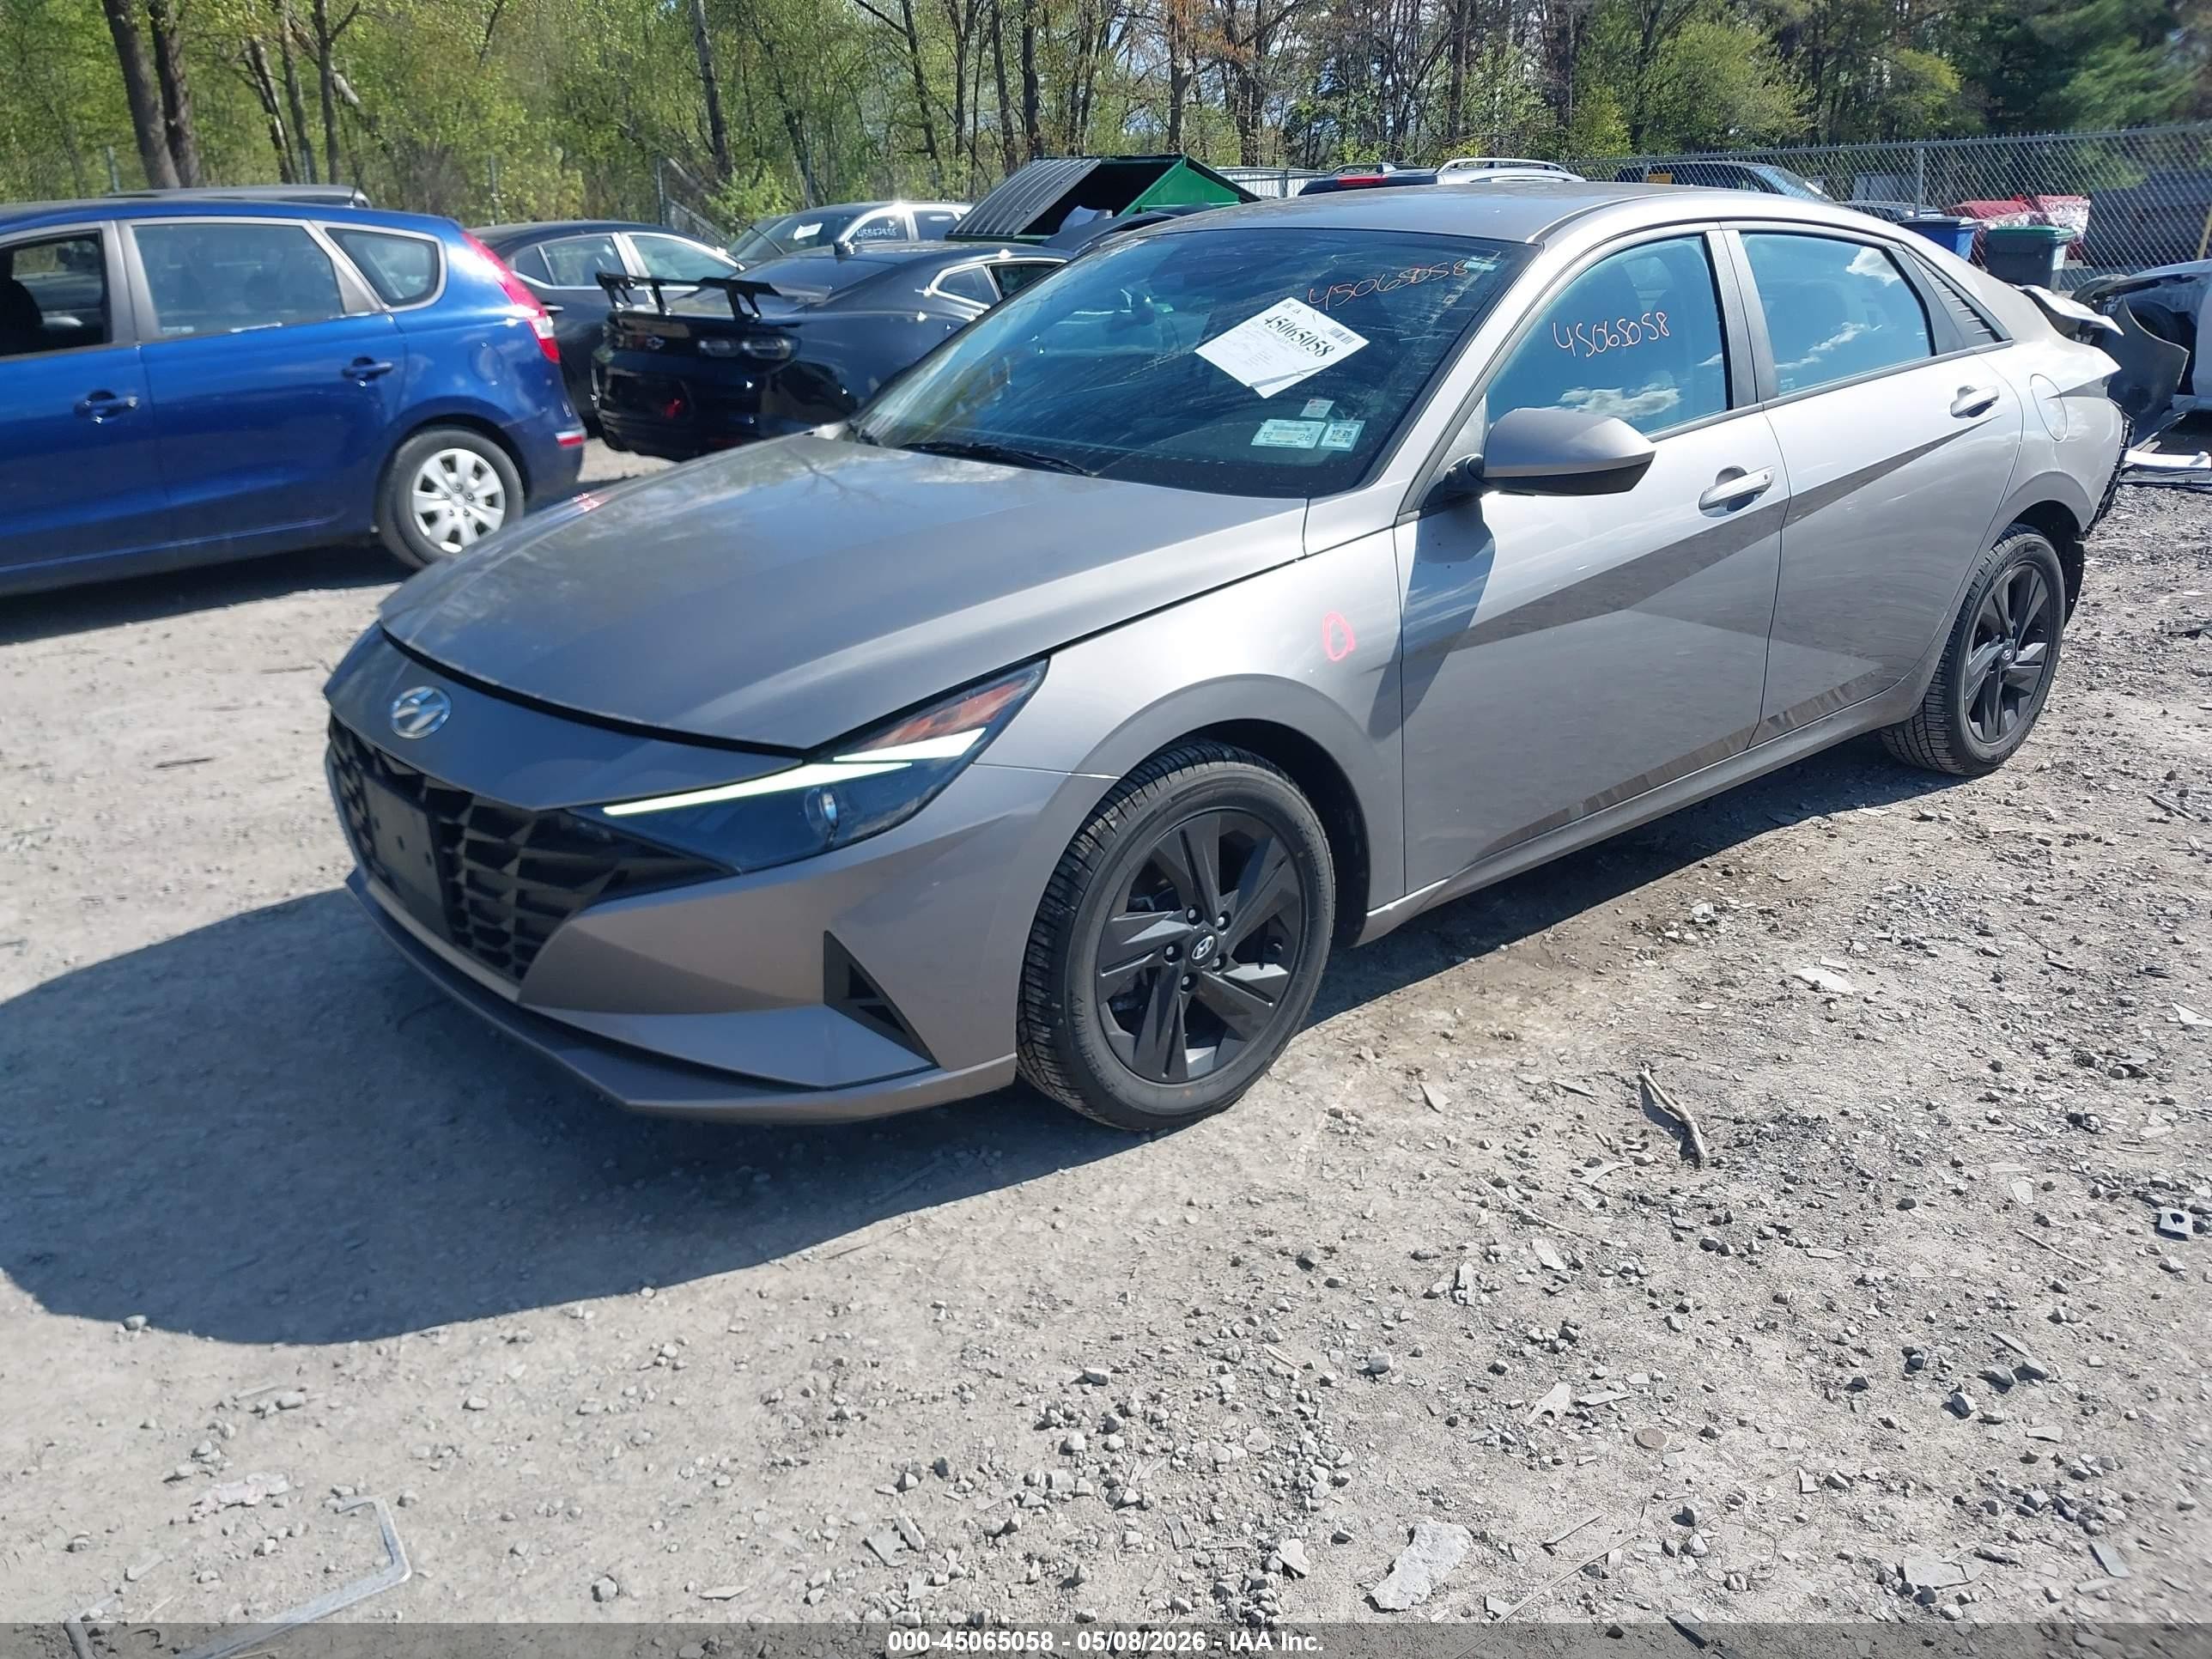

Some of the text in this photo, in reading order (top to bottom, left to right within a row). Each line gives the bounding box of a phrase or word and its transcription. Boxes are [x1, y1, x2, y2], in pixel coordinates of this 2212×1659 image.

[1308, 259, 1469, 311] 45065058
[1264, 315, 1335, 357] 45065058
[1553, 311, 1671, 357] 45065058
